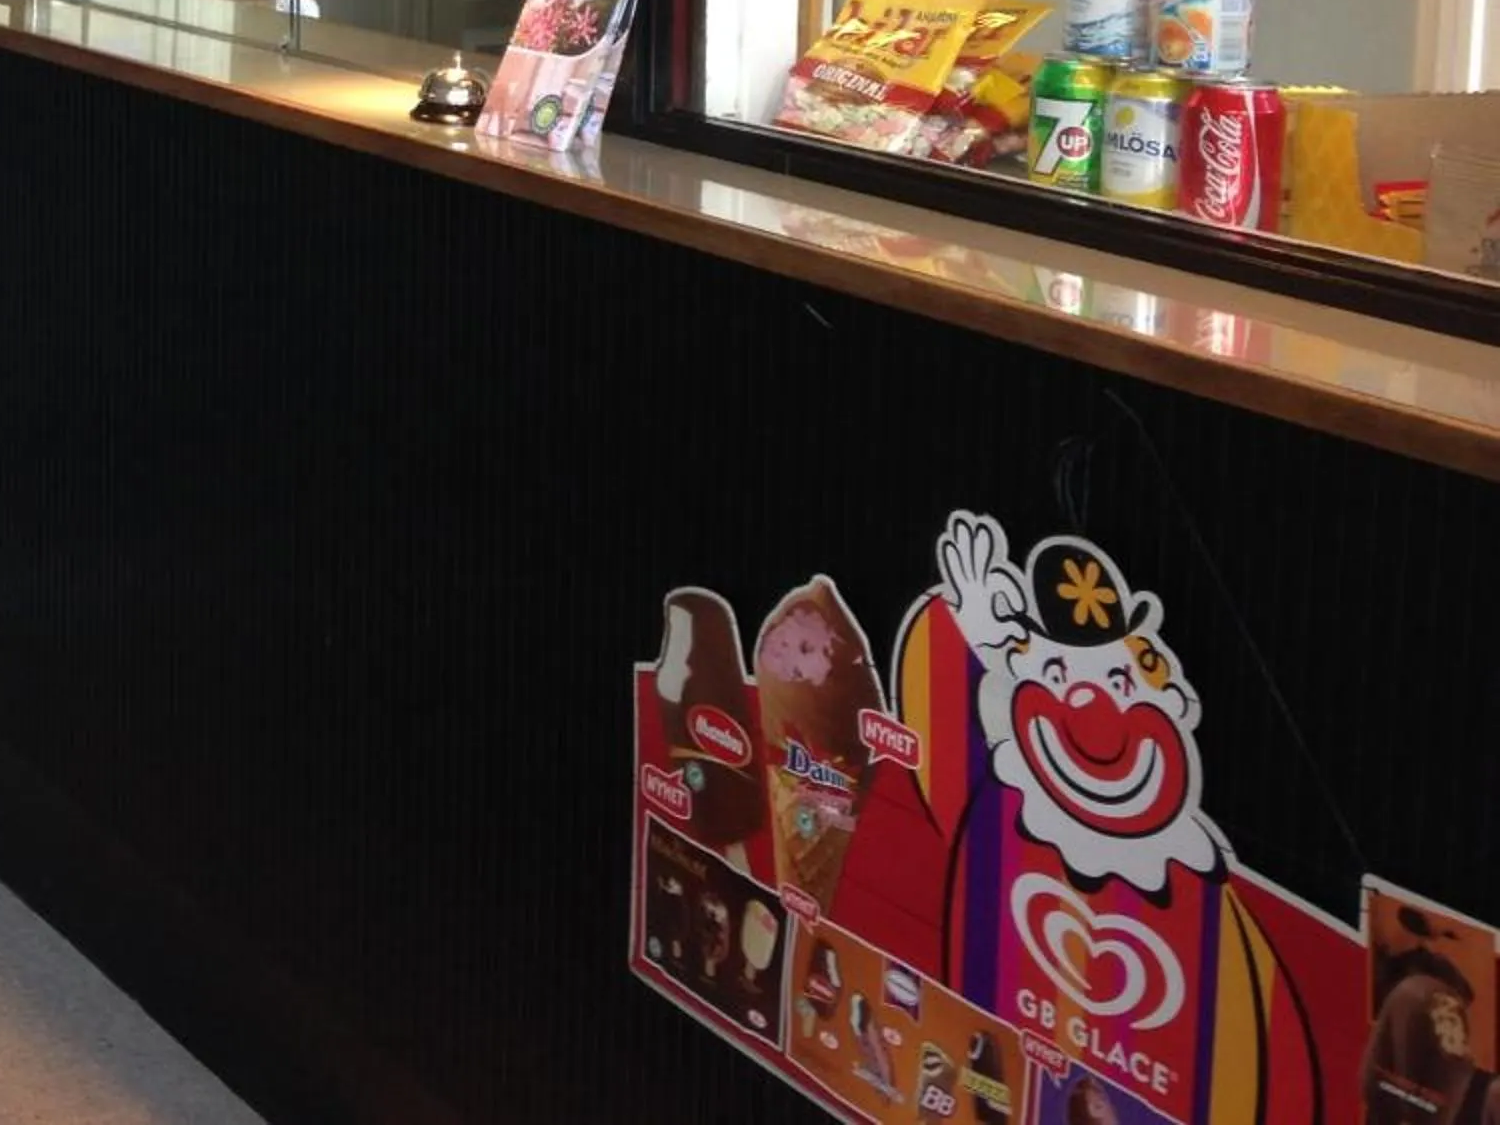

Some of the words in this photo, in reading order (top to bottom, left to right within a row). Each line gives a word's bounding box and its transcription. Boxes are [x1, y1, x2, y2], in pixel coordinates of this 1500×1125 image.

[812, 63, 890, 103] ORIGINAL
[865, 718, 916, 756] NYHET
[786, 740, 848, 786] Daim
[647, 773, 686, 806] NYHET
[1016, 988, 1056, 1029] GB
[1067, 1016, 1170, 1096] GLACE
